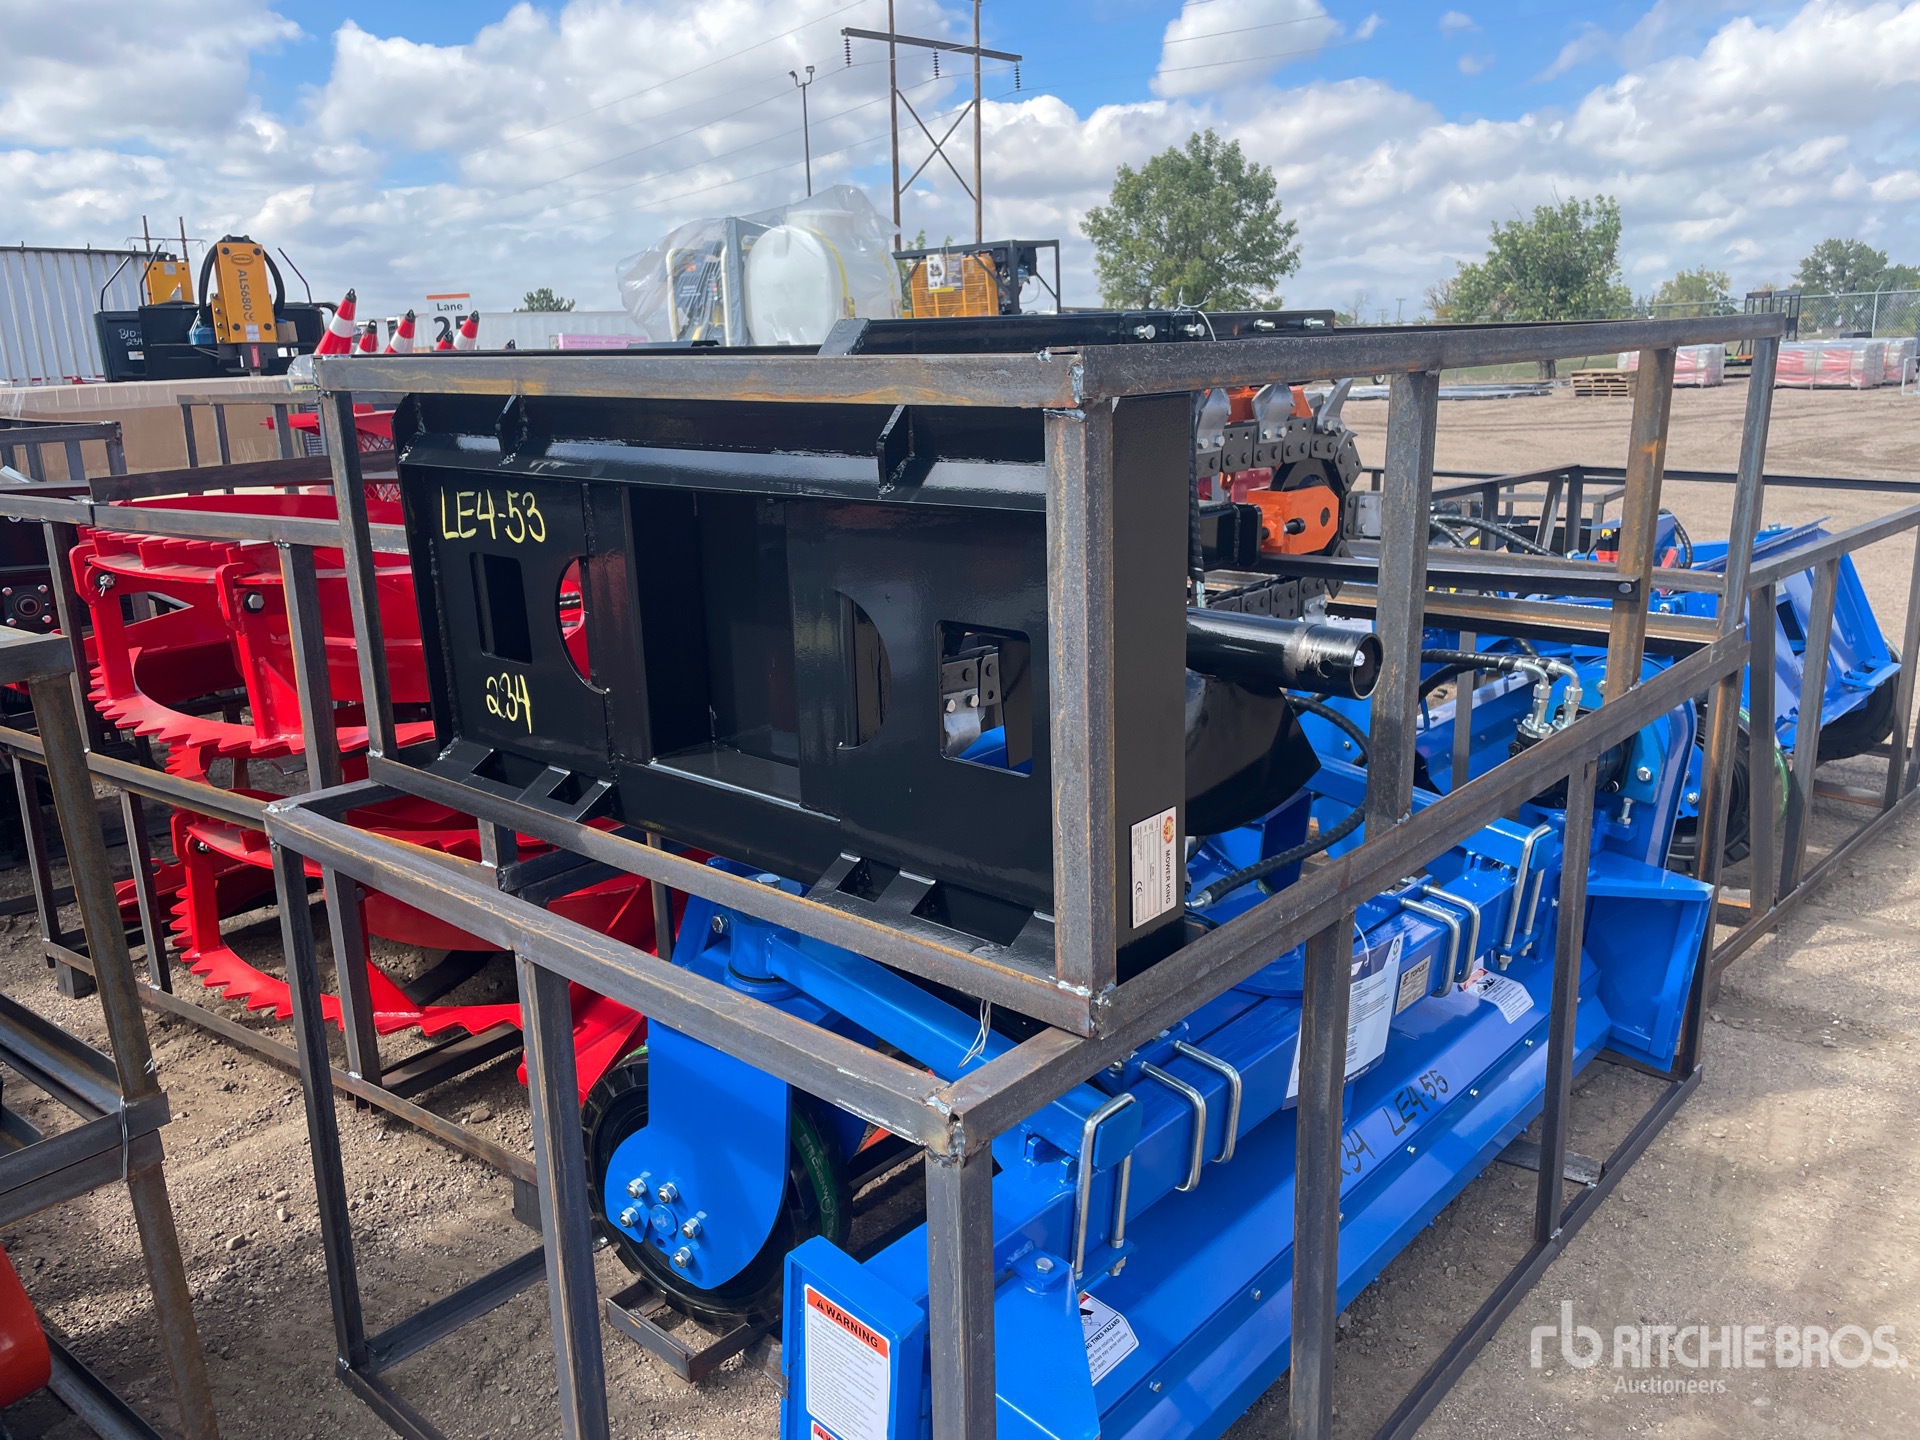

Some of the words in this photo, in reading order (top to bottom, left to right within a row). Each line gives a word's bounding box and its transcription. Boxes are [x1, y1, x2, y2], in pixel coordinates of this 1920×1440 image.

[436, 303, 463, 312] Lane
[441, 486, 546, 544] LE4-53
[486, 672, 532, 735] 234
[825, 1304, 878, 1348] WARNING
[1091, 1332, 1105, 1345] TINES
[1103, 1318, 1121, 1335] HAZARD
